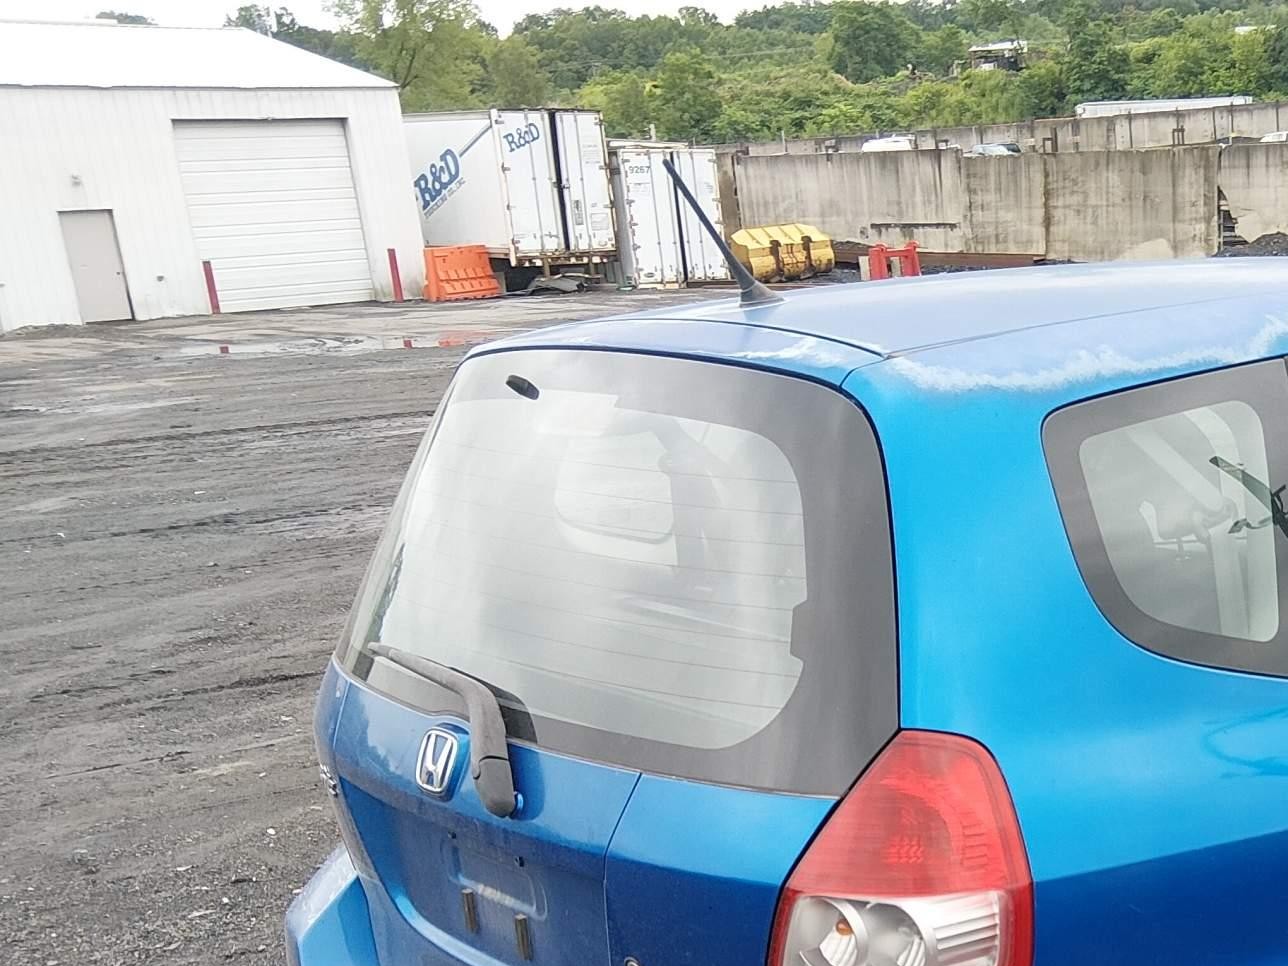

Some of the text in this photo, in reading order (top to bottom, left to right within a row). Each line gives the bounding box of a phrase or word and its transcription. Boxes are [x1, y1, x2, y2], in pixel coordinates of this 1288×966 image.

[503, 122, 541, 152] R&D
[414, 148, 461, 211] R&D
[628, 165, 651, 174] 9267
